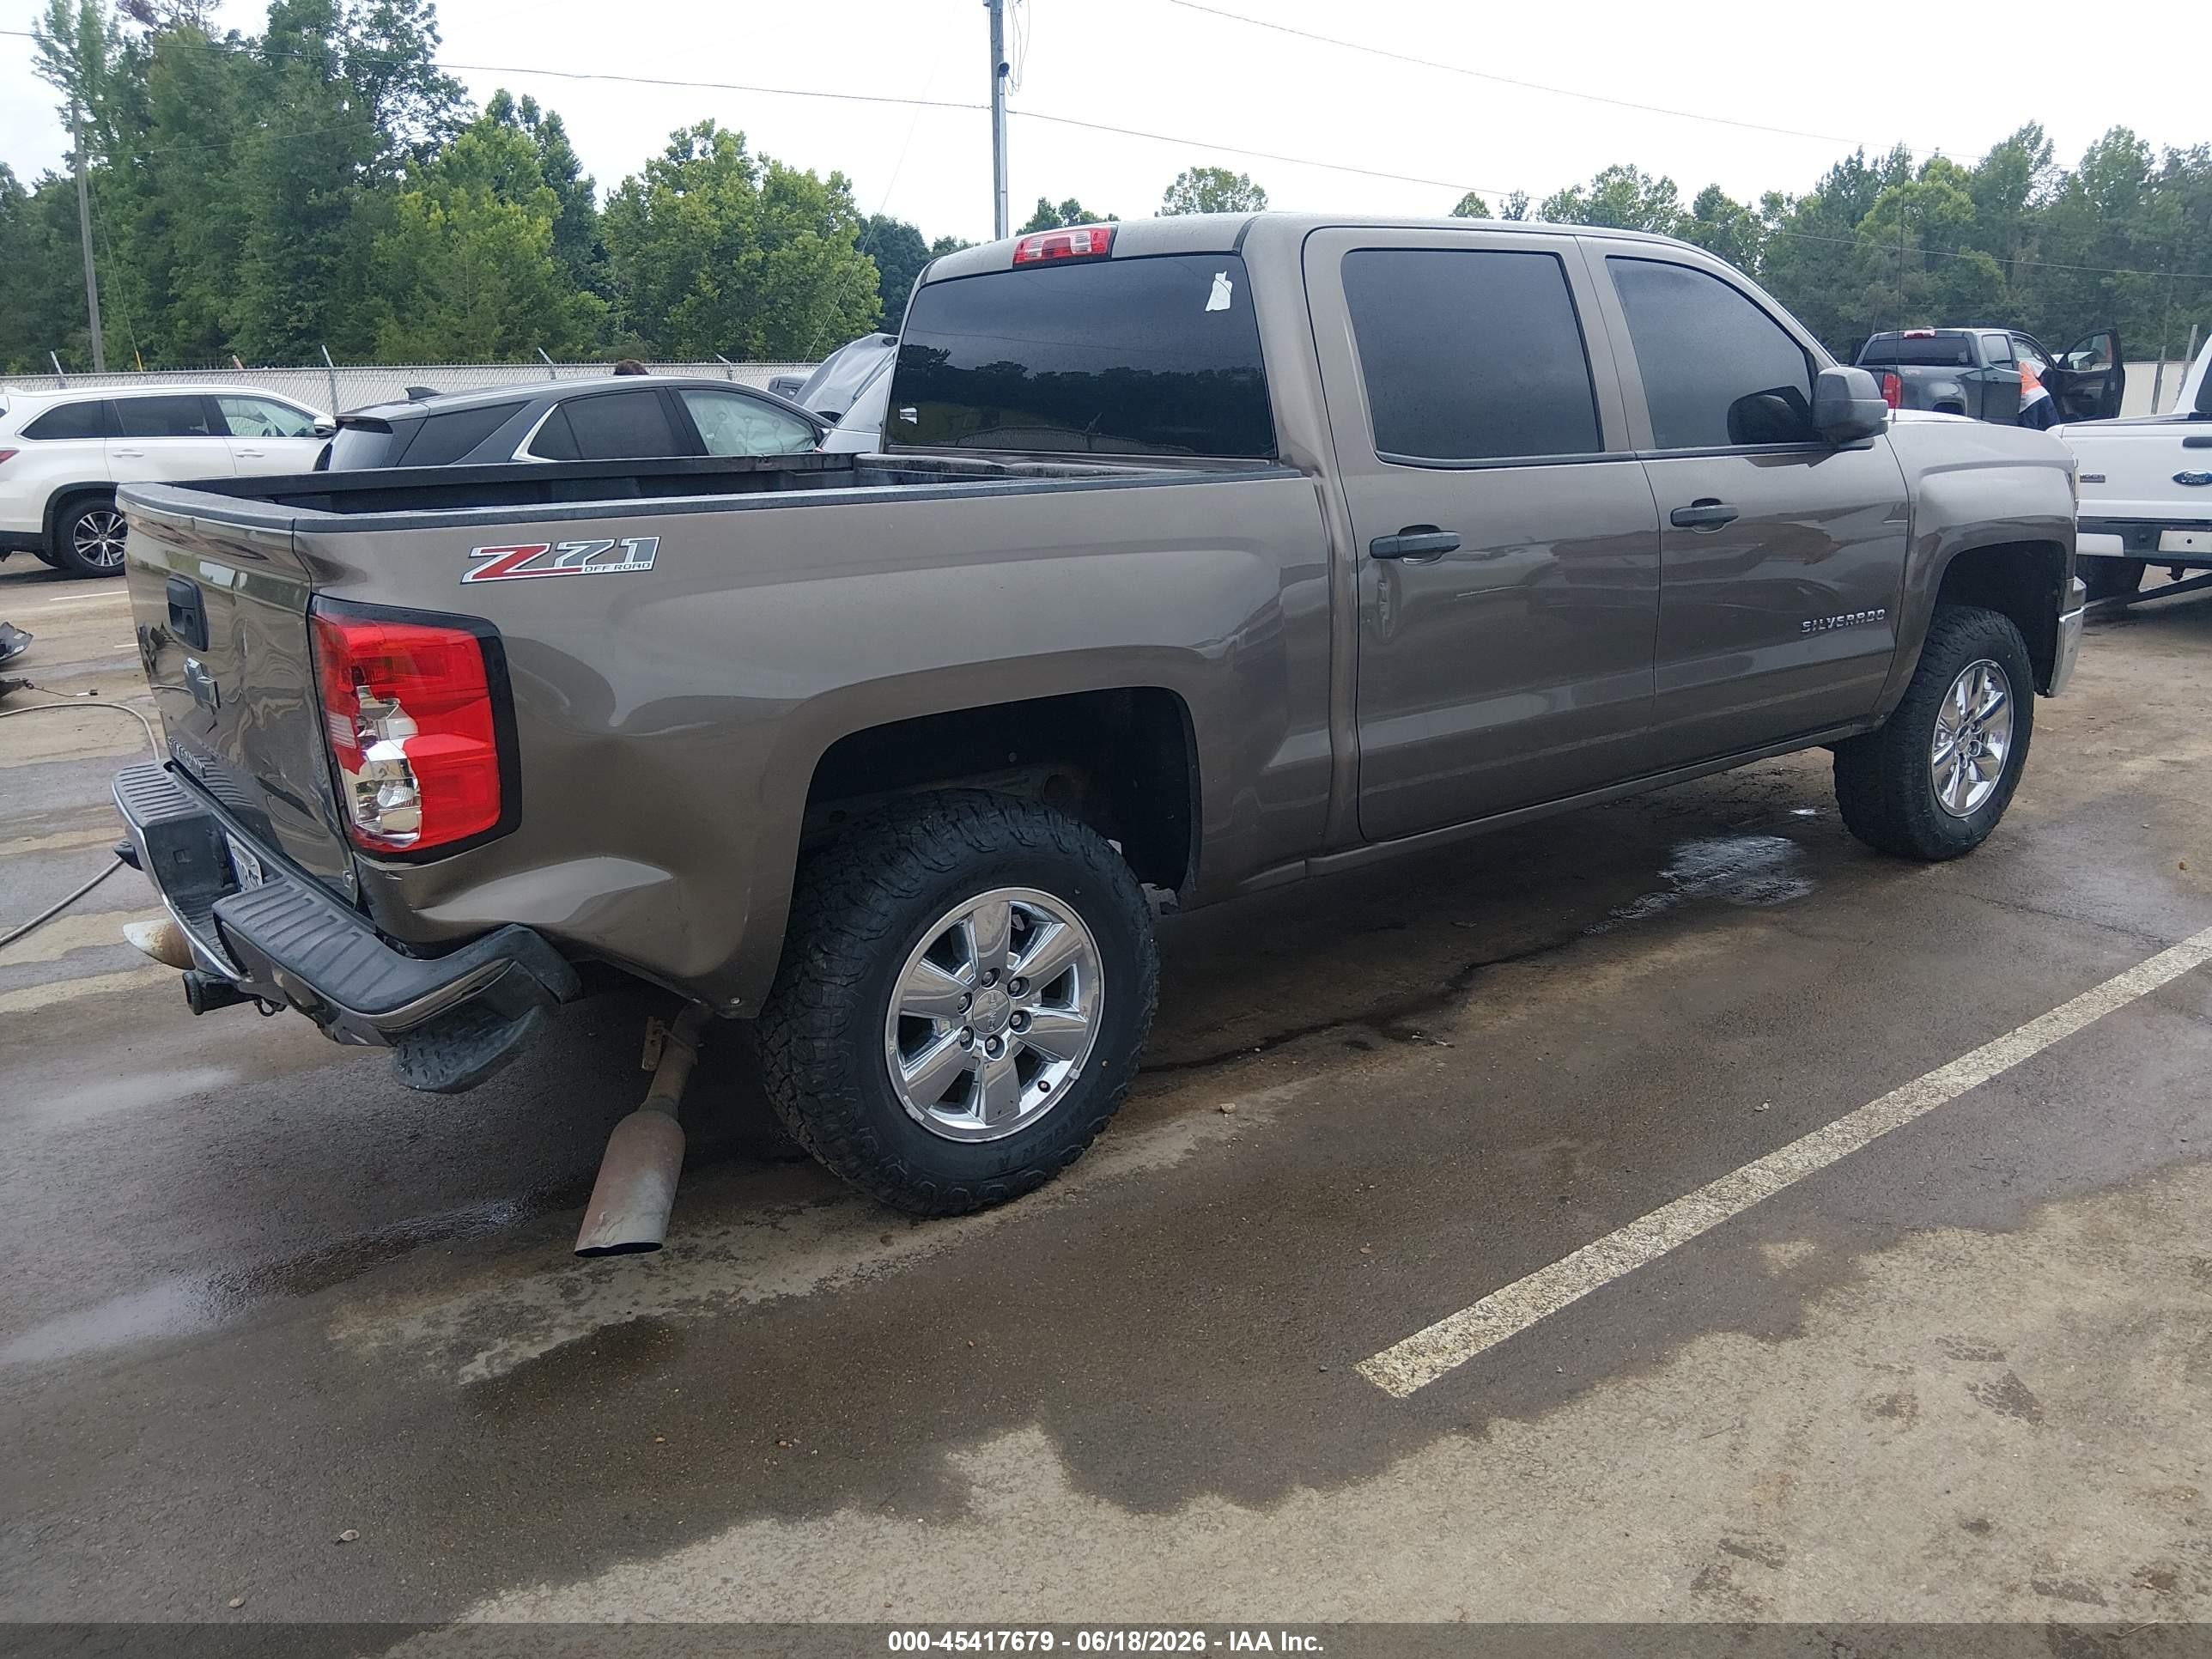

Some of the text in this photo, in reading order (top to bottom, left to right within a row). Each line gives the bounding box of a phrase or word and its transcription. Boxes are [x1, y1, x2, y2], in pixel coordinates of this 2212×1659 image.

[460, 536, 661, 585] Z71
[584, 562, 651, 573] OFF ROAD
[1801, 609, 1887, 633] SILVERADO
